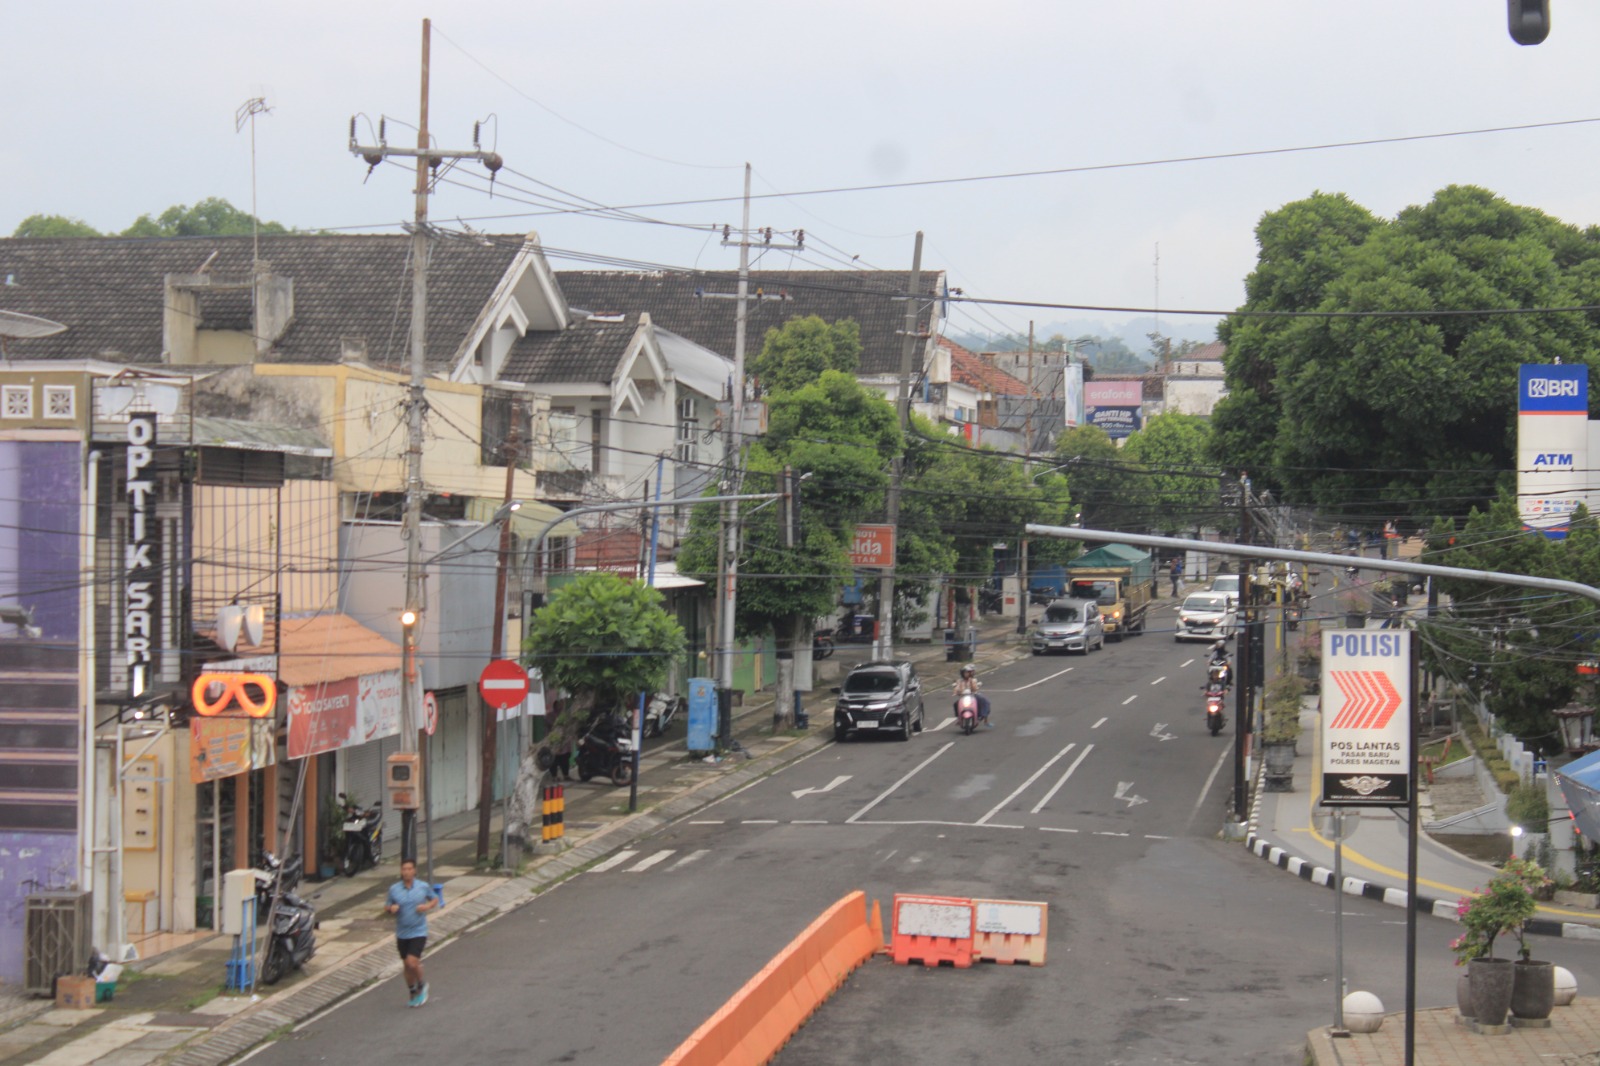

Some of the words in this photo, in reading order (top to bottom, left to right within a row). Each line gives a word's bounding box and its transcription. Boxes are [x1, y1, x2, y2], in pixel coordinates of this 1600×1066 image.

[1090, 389, 1133, 400] erafone
[1548, 379, 1579, 397] BRI
[1533, 453, 1574, 465] ATM
[127, 418, 153, 570] OPTIK
[127, 581, 153, 698] SARI
[1331, 634, 1400, 657] POLISI
[1330, 742, 1353, 750] POS
[1356, 742, 1401, 750] LANTAS
